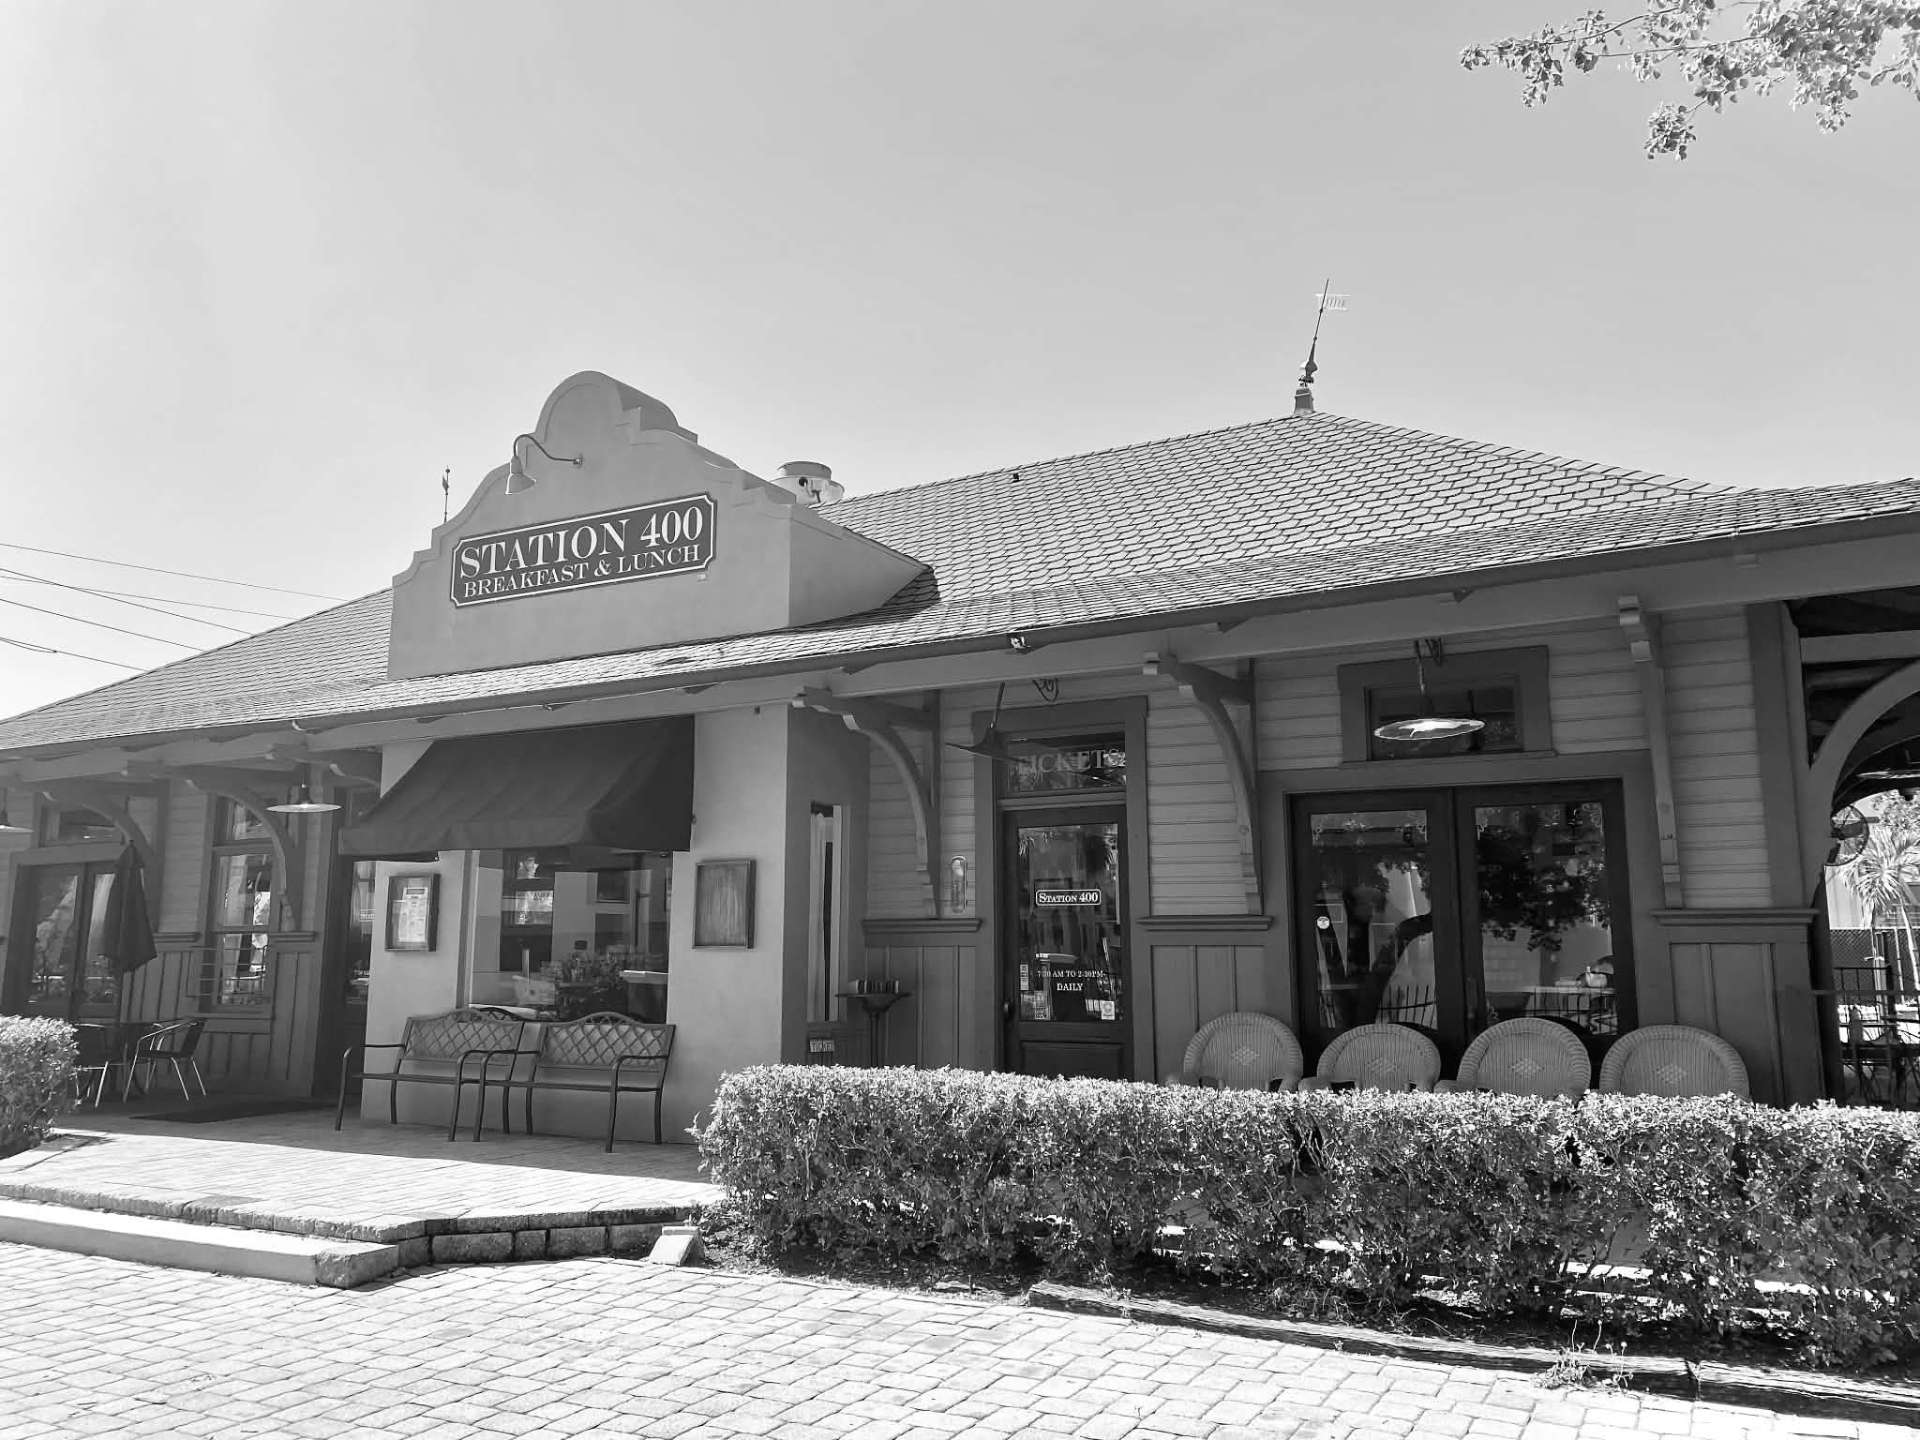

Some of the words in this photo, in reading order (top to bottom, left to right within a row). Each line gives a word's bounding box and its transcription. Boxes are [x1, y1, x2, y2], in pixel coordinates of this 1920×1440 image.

[460, 519, 630, 579] STATION
[639, 506, 704, 549] 400
[463, 562, 589, 598] BREAKFAST
[593, 559, 612, 577] &
[617, 544, 700, 573] LUNCH
[1079, 892, 1098, 903] 400
[1052, 970, 1064, 978] AM
[1065, 970, 1076, 978] TO
[1056, 982, 1083, 991] DAILY
